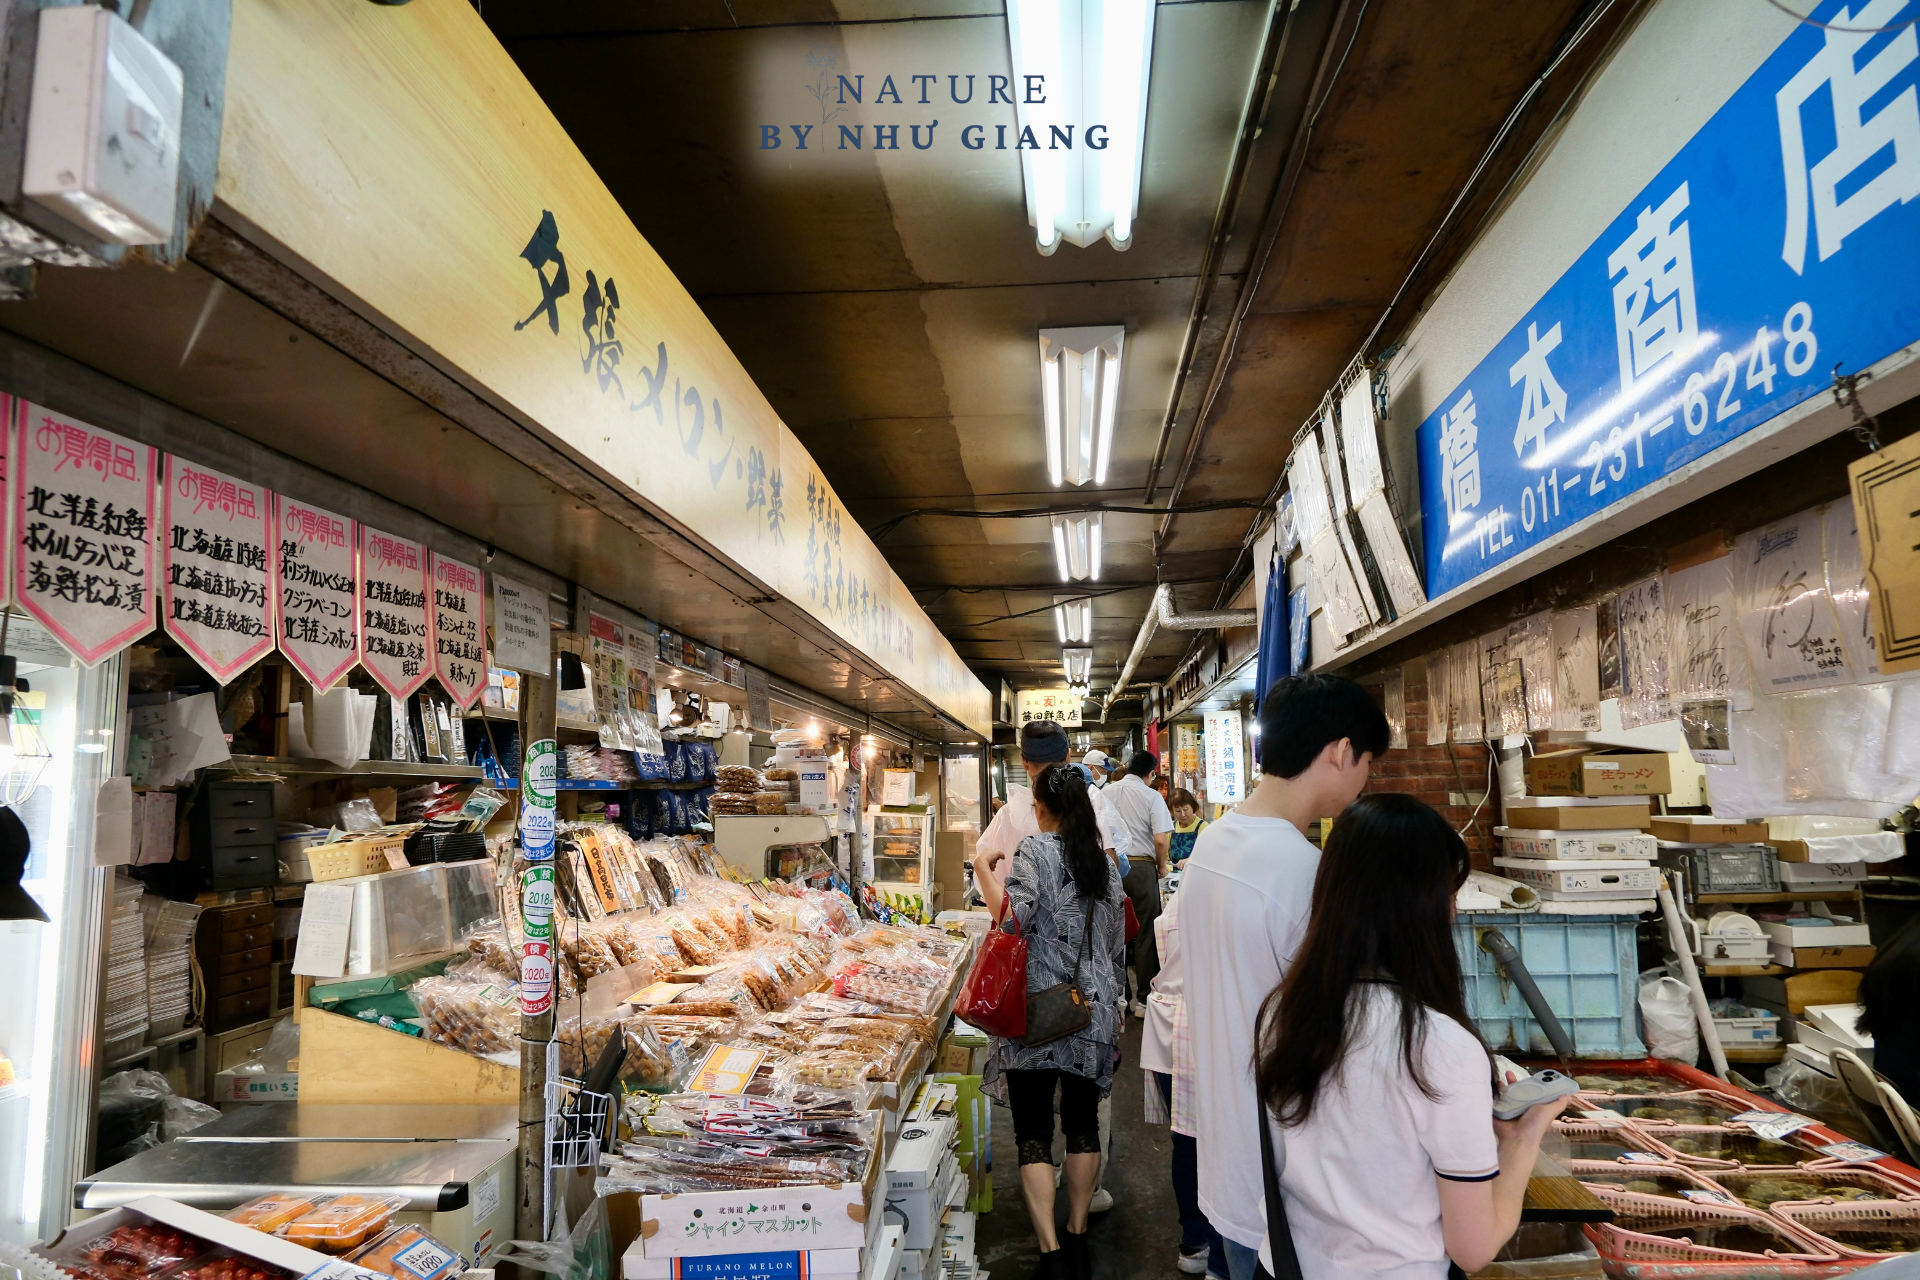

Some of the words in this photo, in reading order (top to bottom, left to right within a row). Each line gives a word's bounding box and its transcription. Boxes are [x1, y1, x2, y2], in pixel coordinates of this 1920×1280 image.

[1439, 0, 1920, 527] 橋本商店
[1474, 505, 1514, 560] TEL
[1520, 301, 1818, 534] 011-231-6248
[1223, 746, 1236, 796] 須田商店
[1601, 768, 1654, 780] 生ラーメン
[1722, 826, 1737, 836] FM
[719, 1206, 743, 1214] 北海道
[685, 1215, 822, 1239] シャインマスカット
[689, 1263, 741, 1272] FURANO
[749, 1262, 793, 1271] MELON
